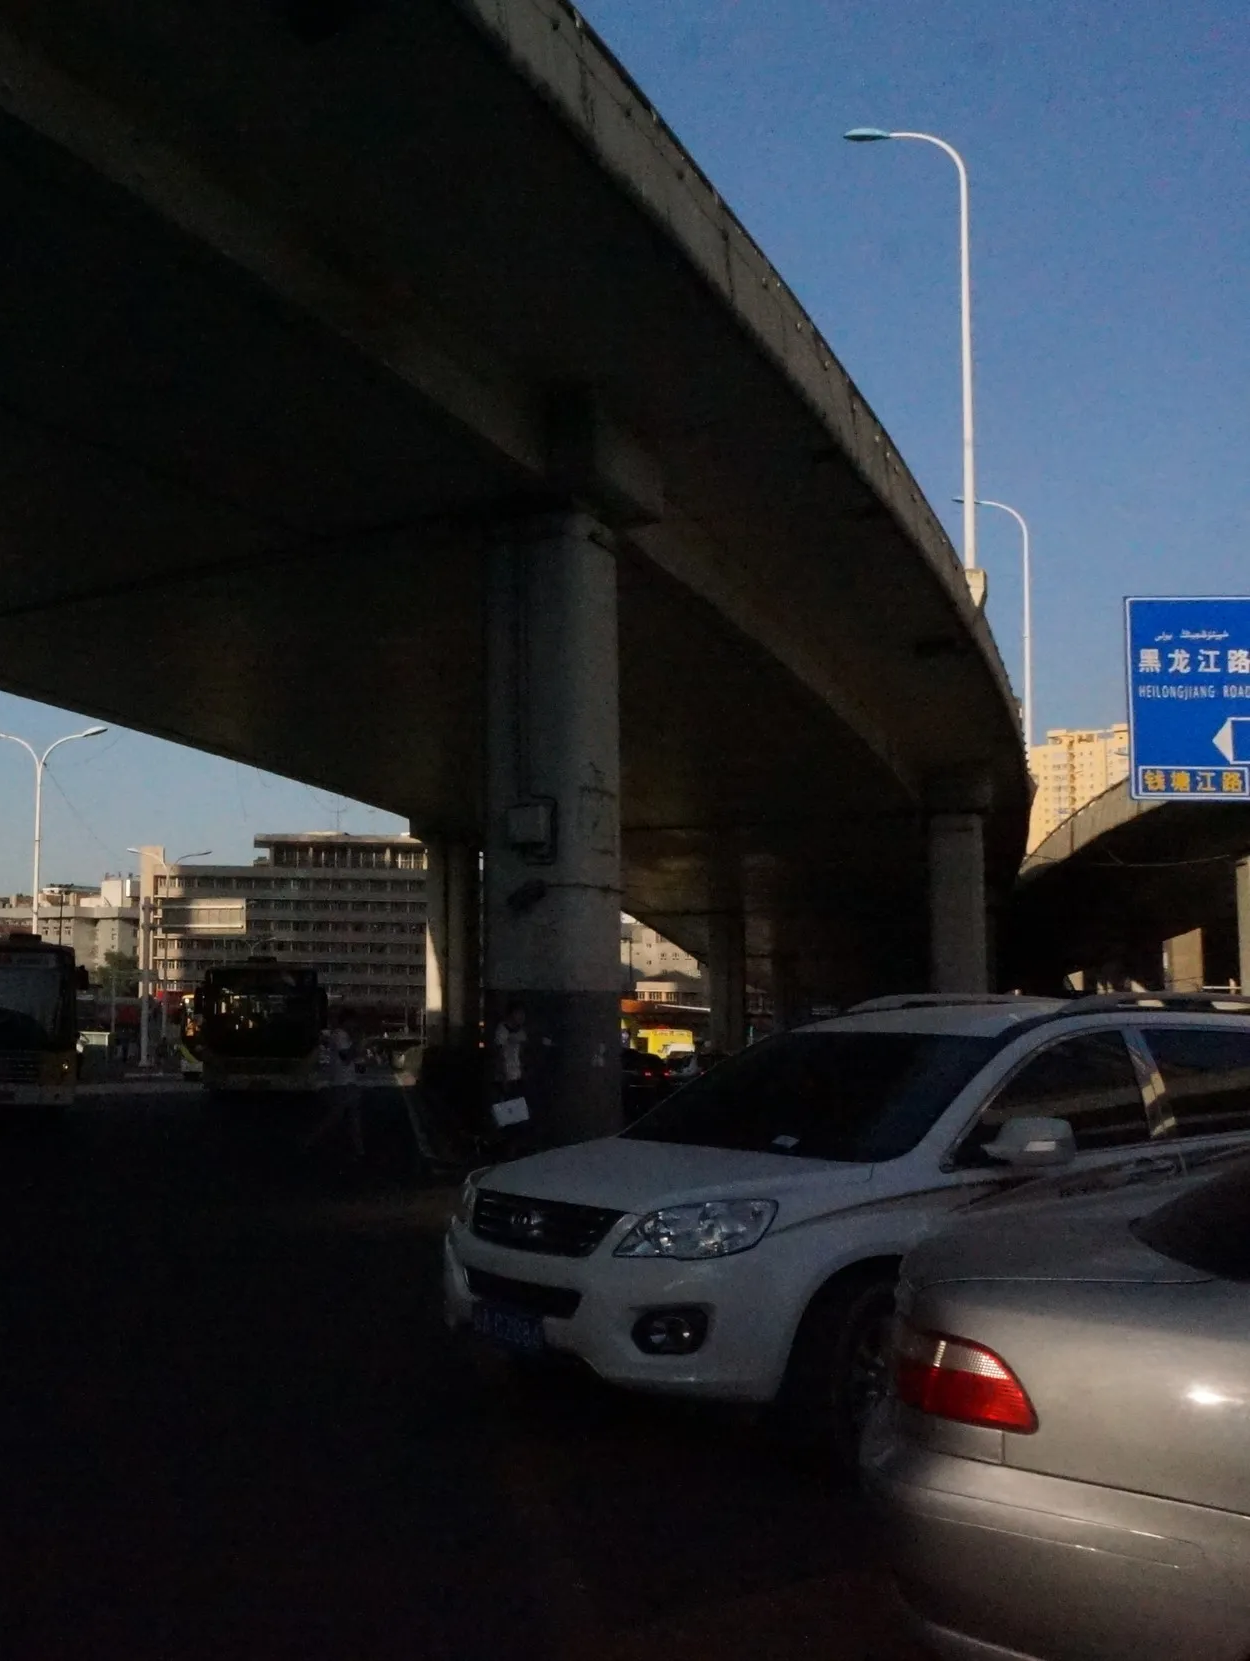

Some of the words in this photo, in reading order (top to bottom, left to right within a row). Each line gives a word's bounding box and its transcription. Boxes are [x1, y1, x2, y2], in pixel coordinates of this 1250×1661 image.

[1138, 648, 1250, 673] 黑龙江路
[1138, 685, 1216, 700] HEILONGJIANG
